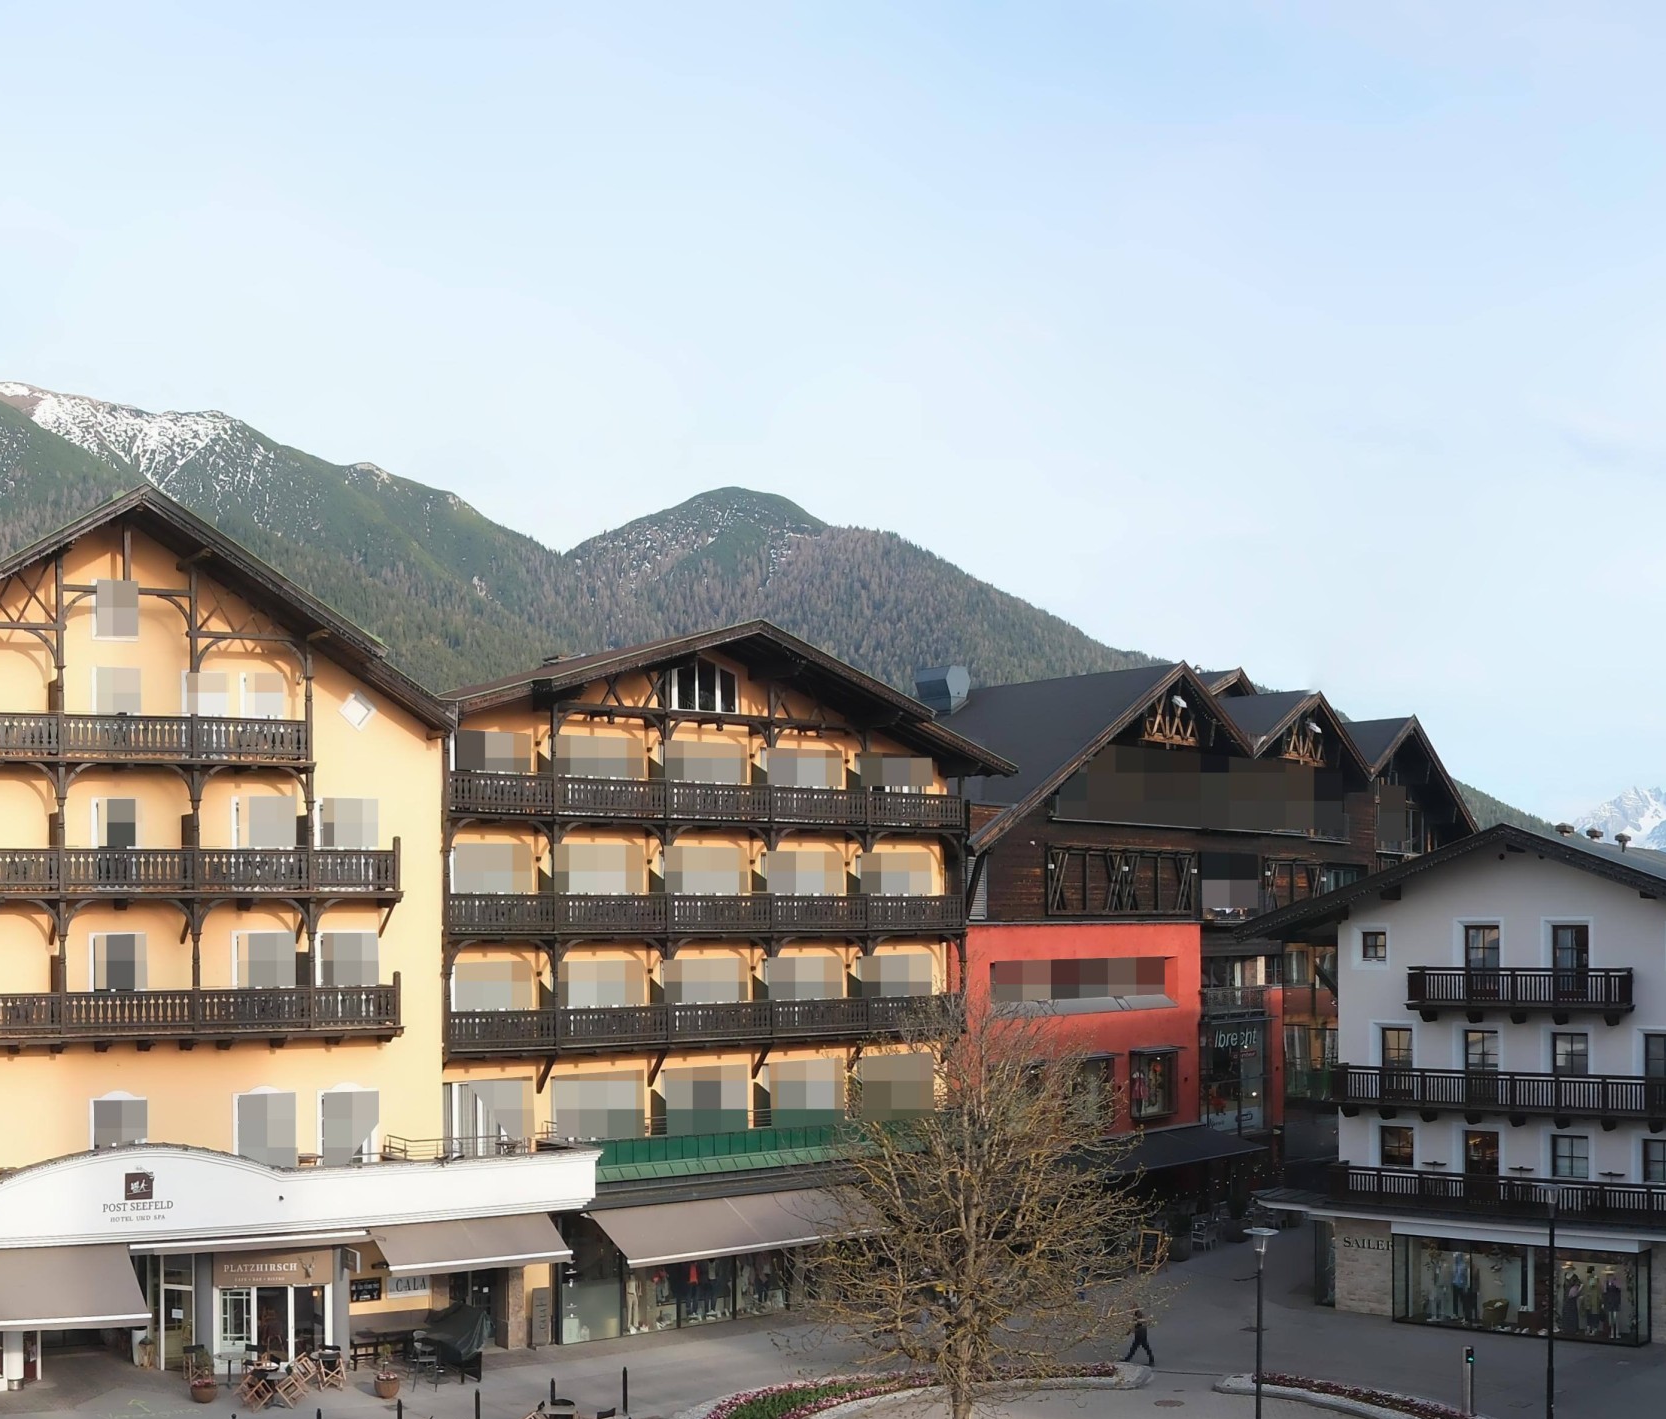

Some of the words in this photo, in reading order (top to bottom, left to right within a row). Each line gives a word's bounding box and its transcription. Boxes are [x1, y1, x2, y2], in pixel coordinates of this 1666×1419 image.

[102, 1203, 128, 1213] POST
[130, 1201, 174, 1211] SEEFELD
[223, 1262, 297, 1273] PLATZHIRSCH
